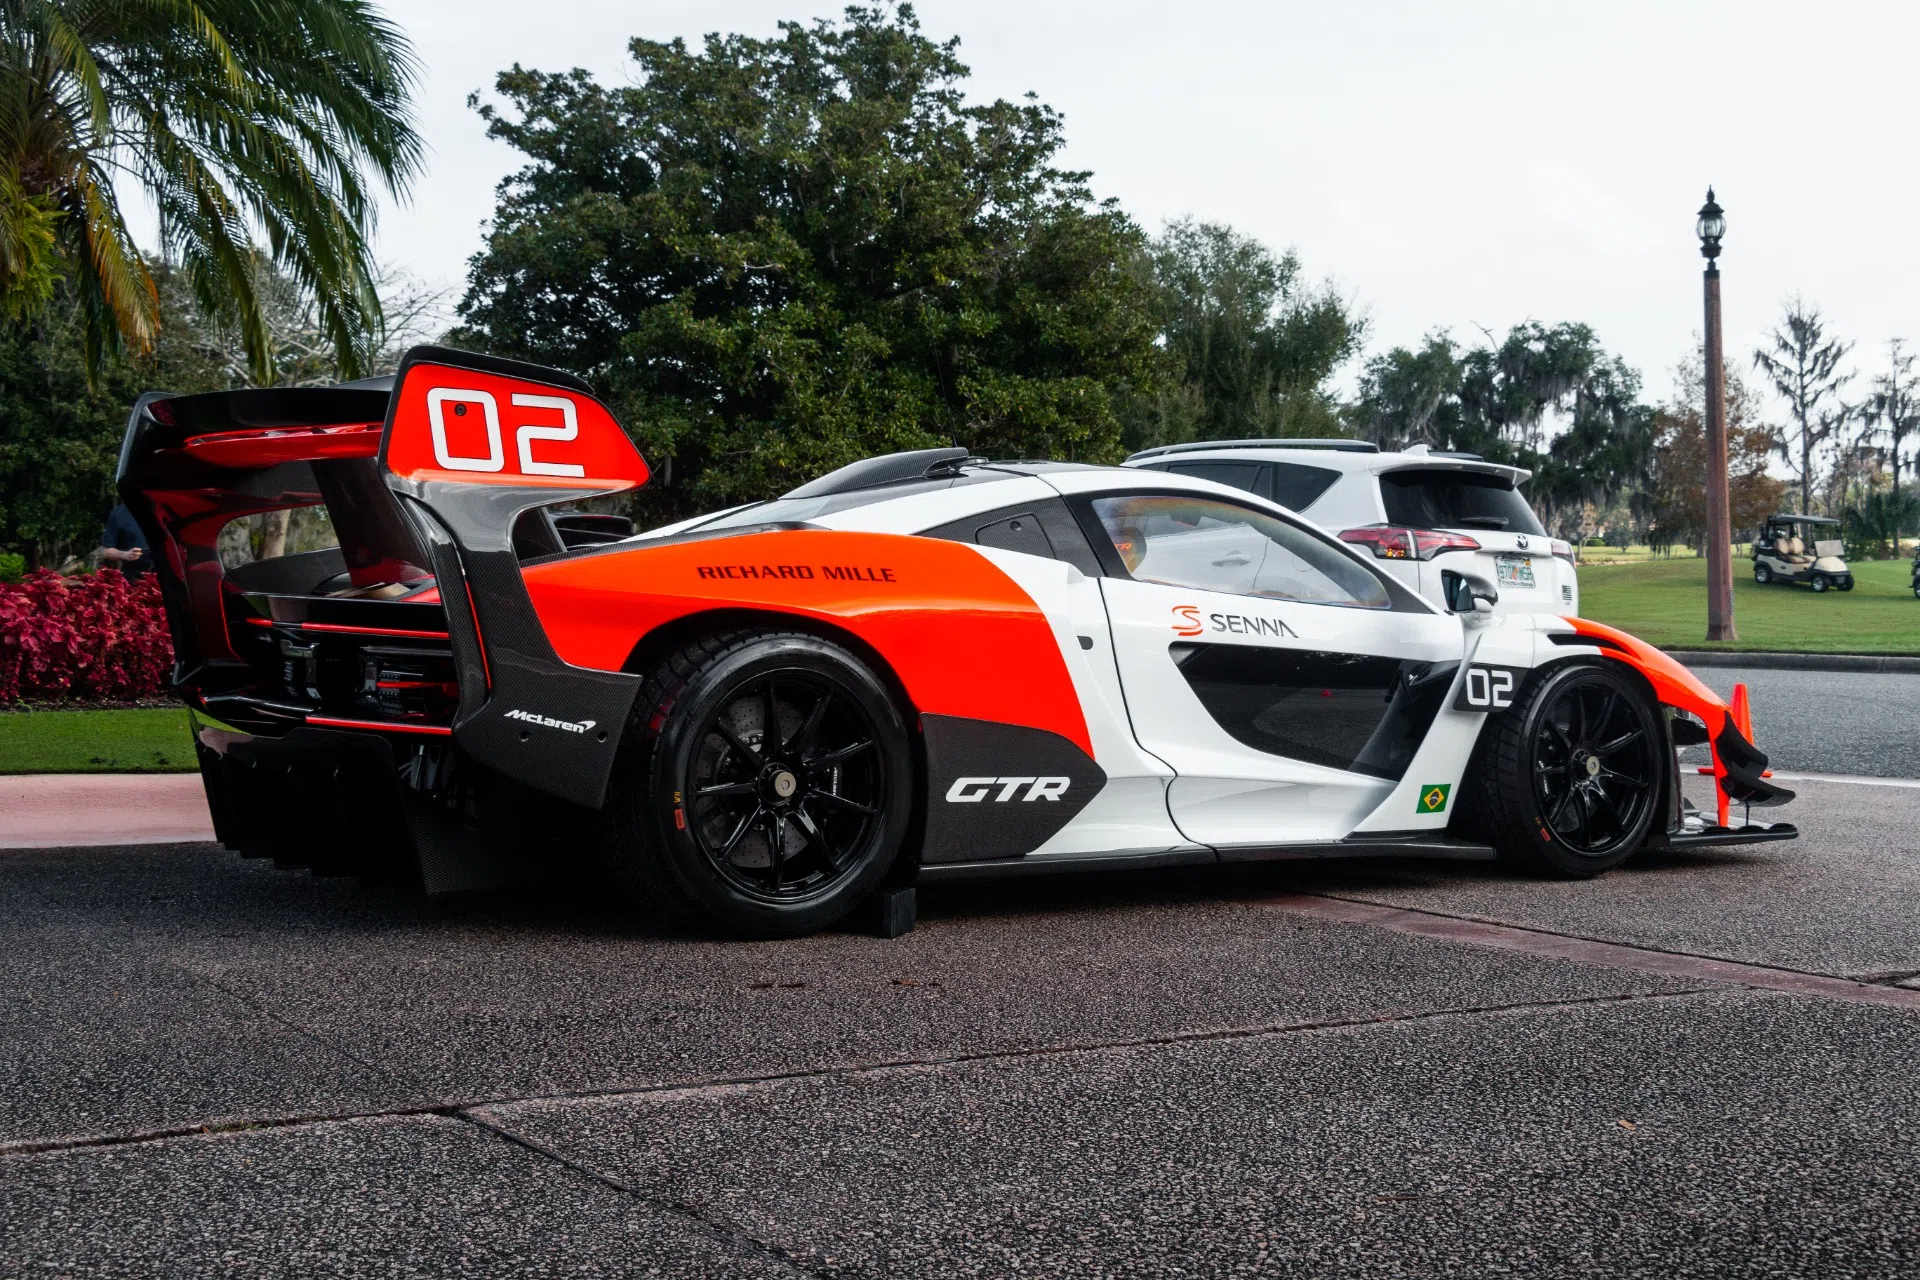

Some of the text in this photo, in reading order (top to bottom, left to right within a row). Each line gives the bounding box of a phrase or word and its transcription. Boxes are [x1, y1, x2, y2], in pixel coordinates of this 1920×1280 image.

[427, 387, 585, 478] 02
[696, 565, 897, 583] RICHARD MILLE
[1209, 613, 1299, 638] SENNA
[1466, 668, 1513, 708] 02
[503, 709, 585, 734] McLaren
[945, 776, 1071, 803] GTR
